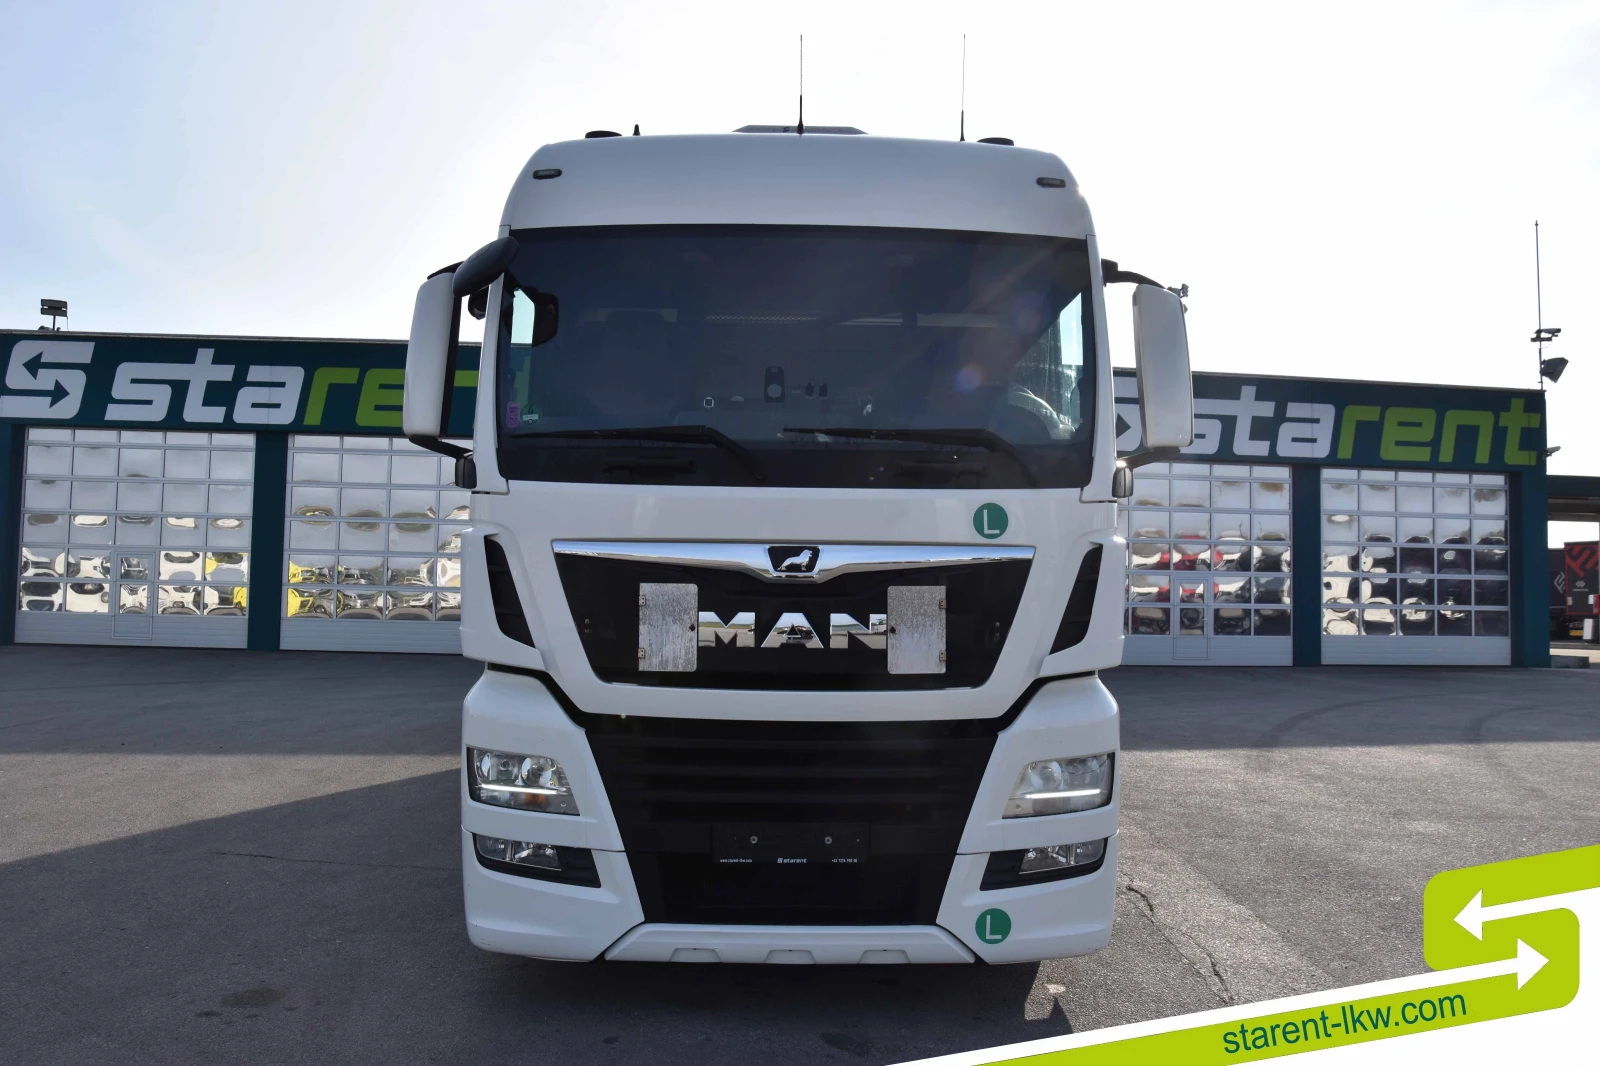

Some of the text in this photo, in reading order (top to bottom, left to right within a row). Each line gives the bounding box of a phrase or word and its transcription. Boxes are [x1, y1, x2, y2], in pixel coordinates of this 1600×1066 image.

[983, 509, 1000, 535] L
[698, 611, 888, 650] MAN
[985, 914, 1002, 940] L
